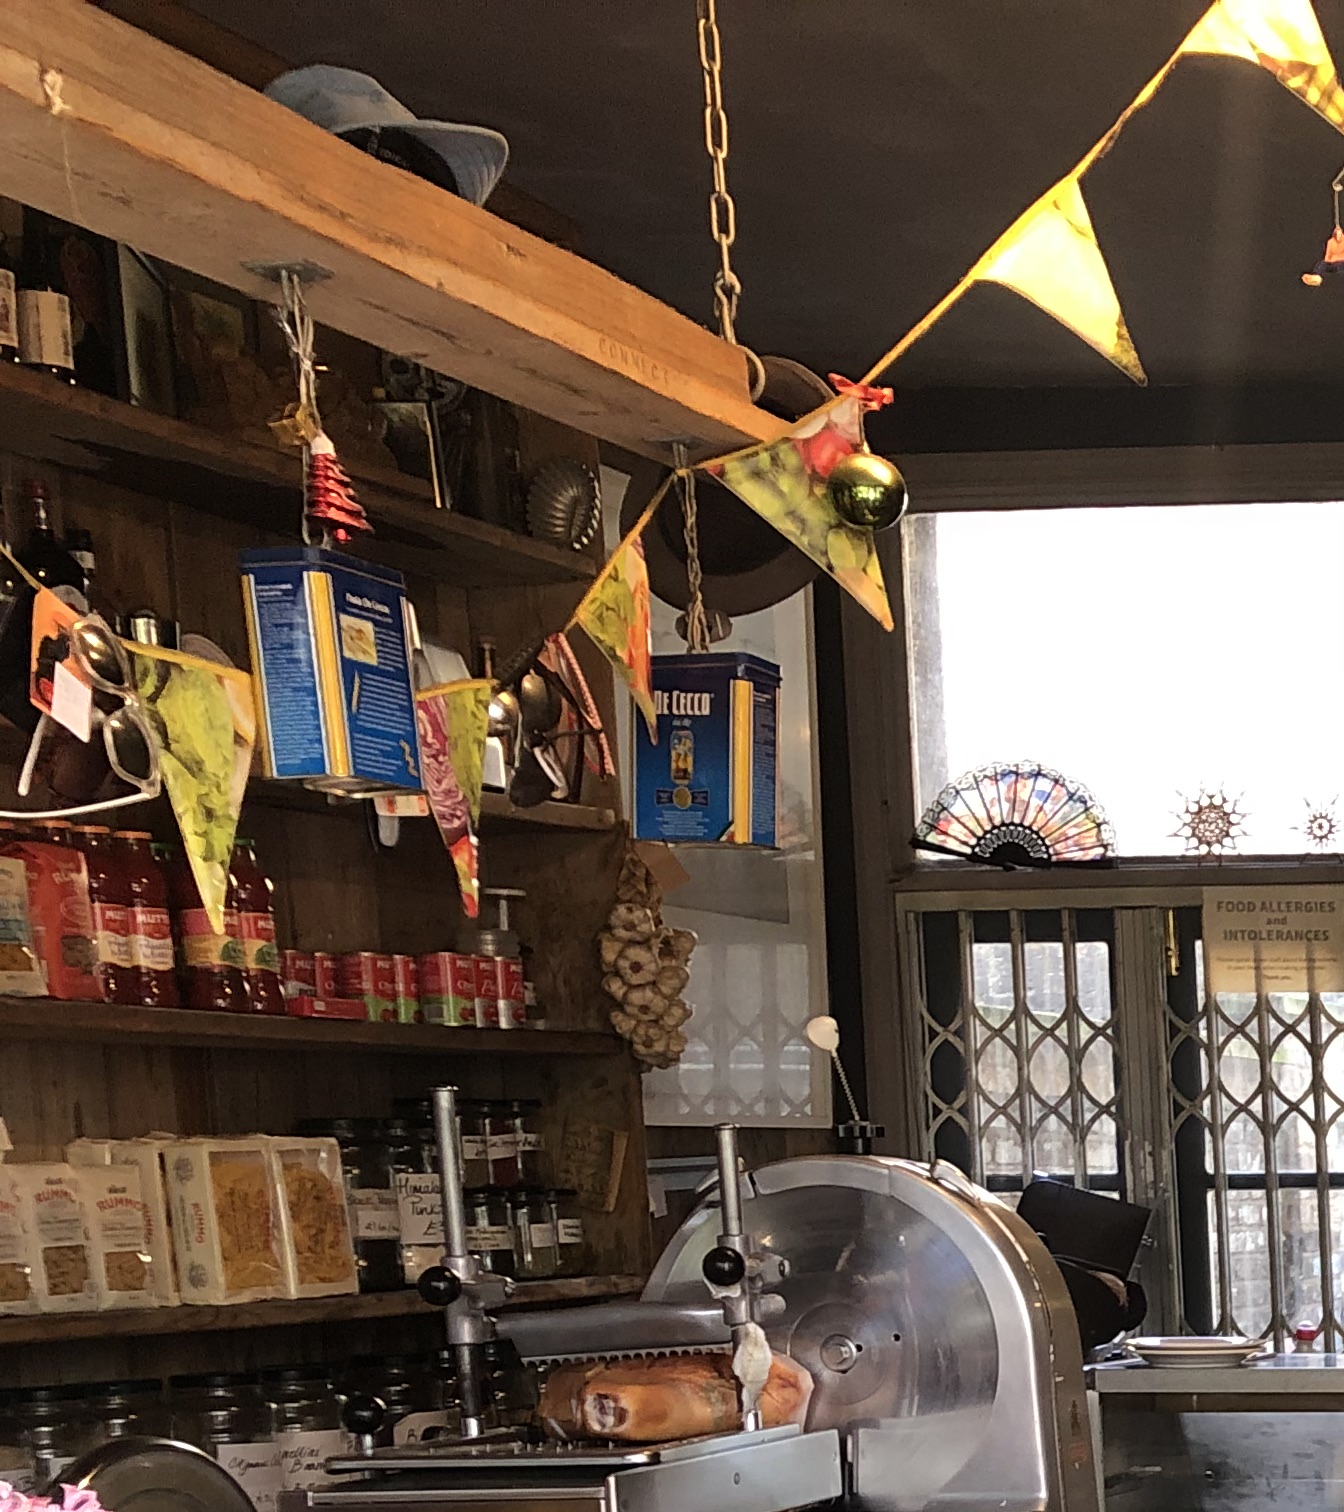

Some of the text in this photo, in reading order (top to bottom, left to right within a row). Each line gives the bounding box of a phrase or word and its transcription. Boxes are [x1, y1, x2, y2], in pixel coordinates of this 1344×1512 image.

[654, 690, 711, 716] DE CECCO
[1216, 901, 1336, 913] FOOD ALLERGIES
[1266, 916, 1288, 925] and
[1223, 929, 1330, 942] INTOLERANCES
[396, 1177, 442, 1195] Himala
